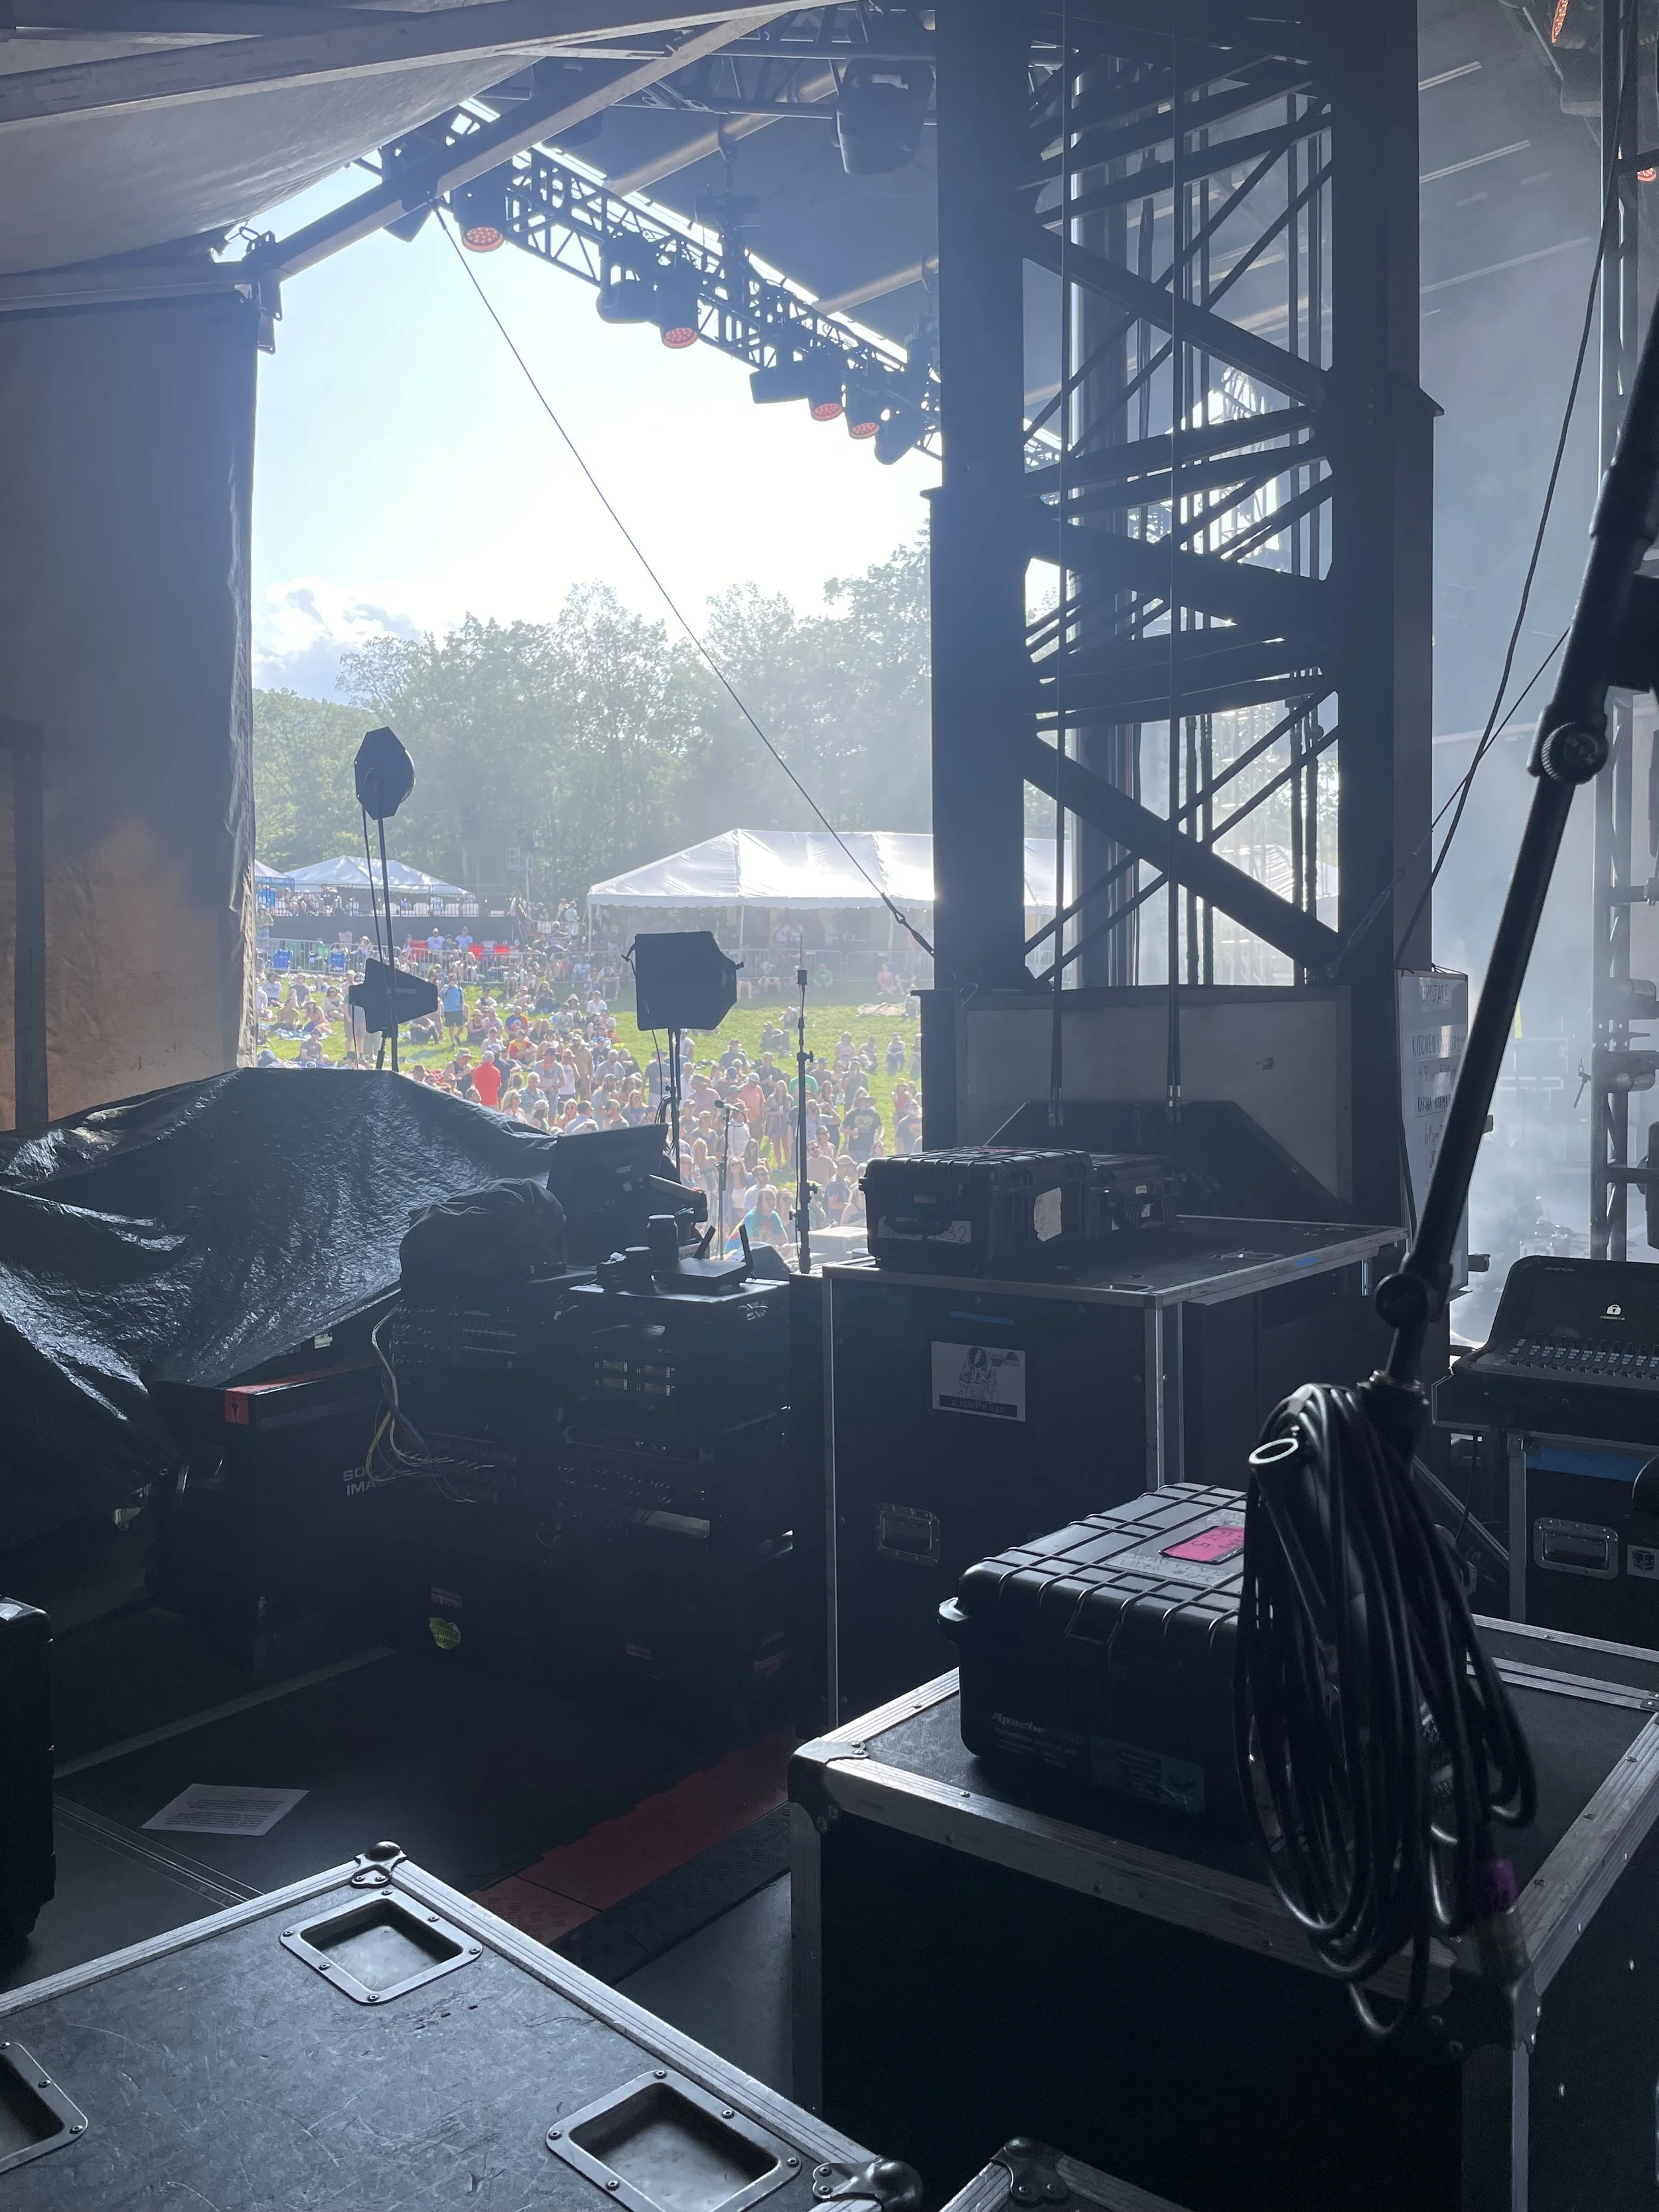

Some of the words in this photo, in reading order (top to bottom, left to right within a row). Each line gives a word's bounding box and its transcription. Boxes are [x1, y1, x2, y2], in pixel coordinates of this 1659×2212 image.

[1421, 984, 1448, 1003] UPSTATE
[1412, 1034, 1436, 1058] KITCHEN
[991, 1711, 1046, 1734] Apache
